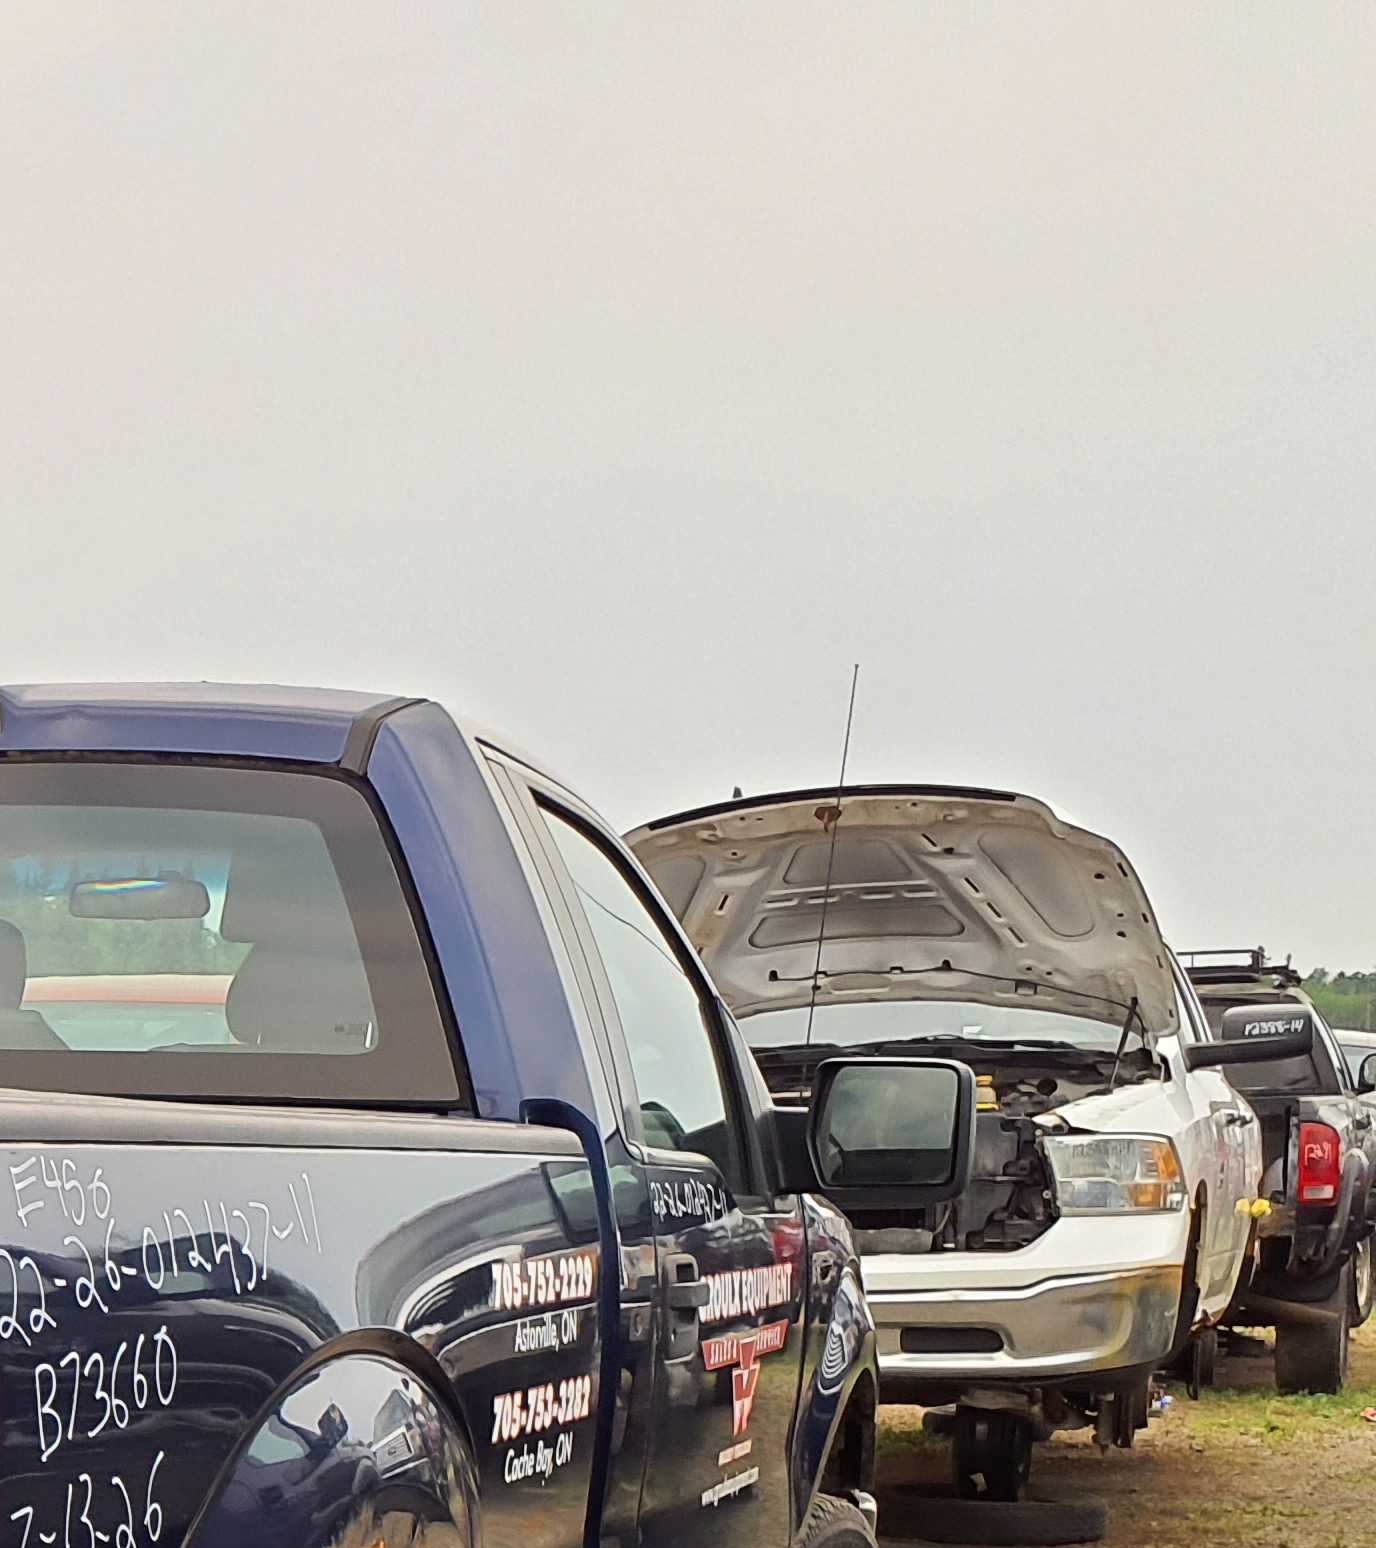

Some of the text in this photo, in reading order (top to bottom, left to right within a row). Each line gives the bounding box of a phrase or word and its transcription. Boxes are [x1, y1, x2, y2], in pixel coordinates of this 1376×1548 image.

[491, 1255, 593, 1311] 705-752-2229
[741, 1262, 793, 1317] EQUIPMENT
[514, 1310, 577, 1353] Astorville, ON
[34, 1325, 178, 1462] B73660
[504, 1443, 535, 1484] Cache
[555, 1431, 574, 1466] ON
